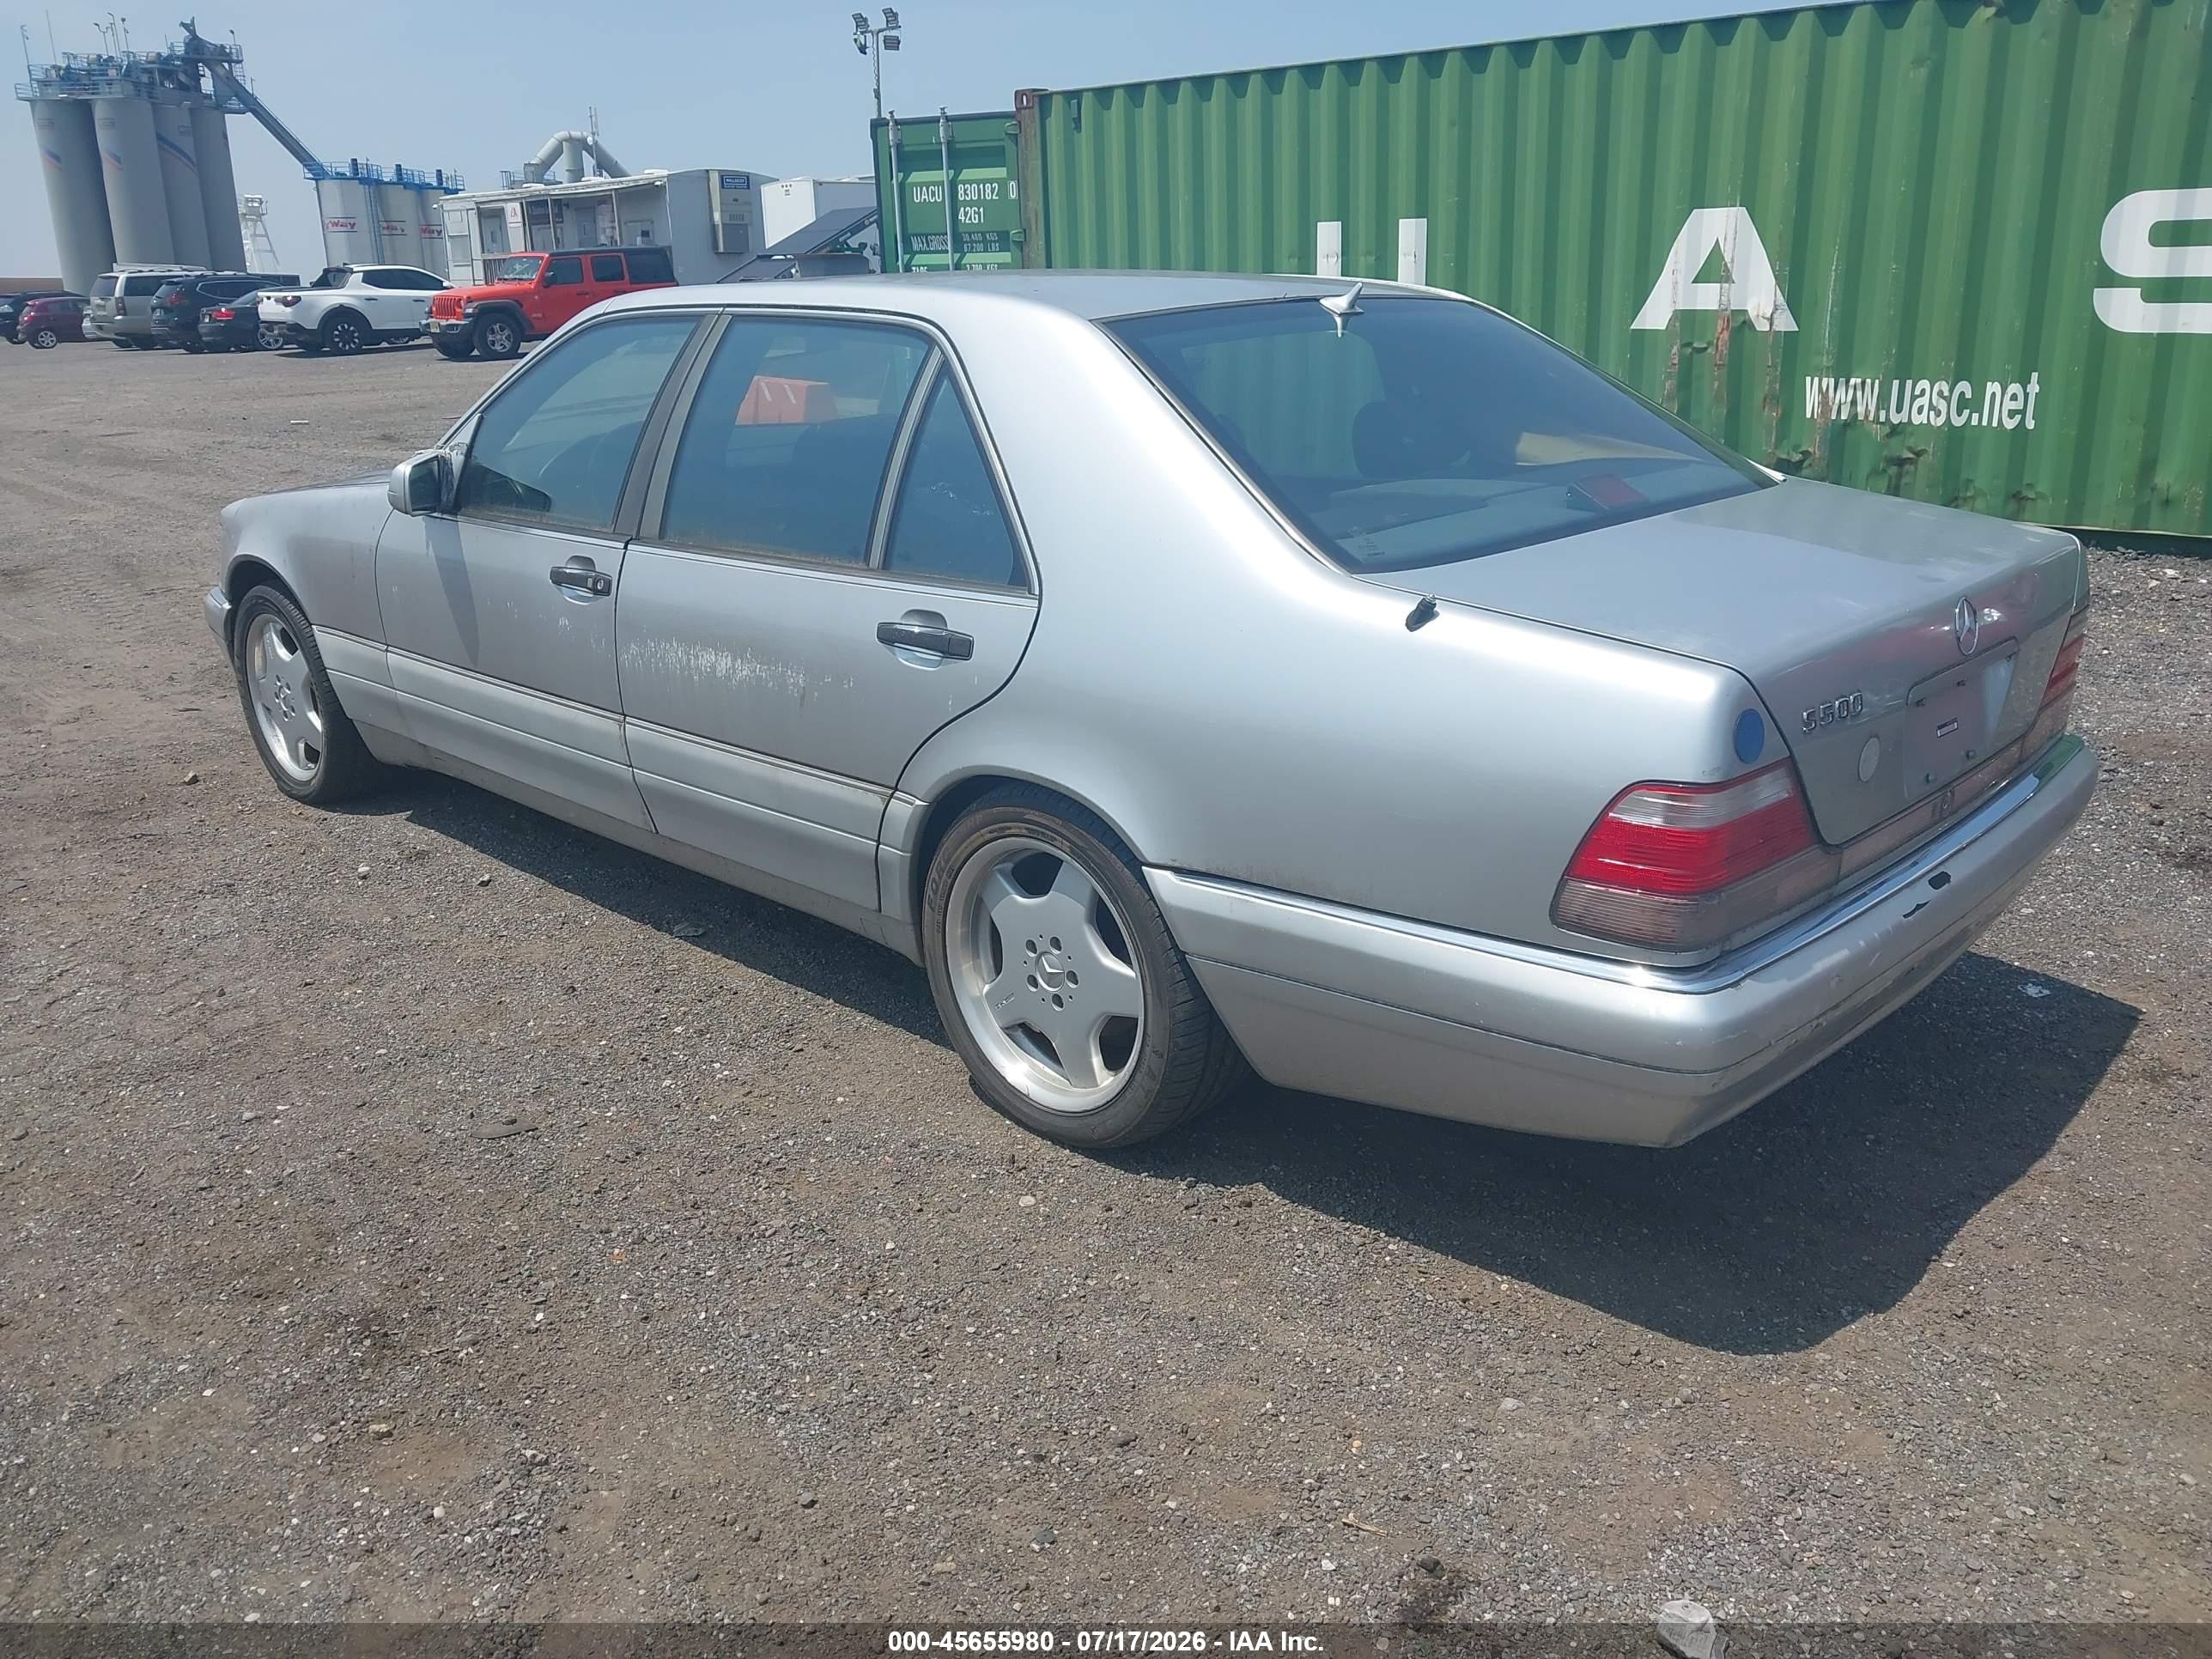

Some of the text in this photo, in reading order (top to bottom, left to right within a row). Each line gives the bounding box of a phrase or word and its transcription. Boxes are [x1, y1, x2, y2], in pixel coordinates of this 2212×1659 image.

[913, 181, 1017, 203] UACU 830182 0
[957, 206, 984, 223] 42G1
[1806, 372, 2039, 428] www.uasc.net
[1802, 691, 1863, 733] S500
